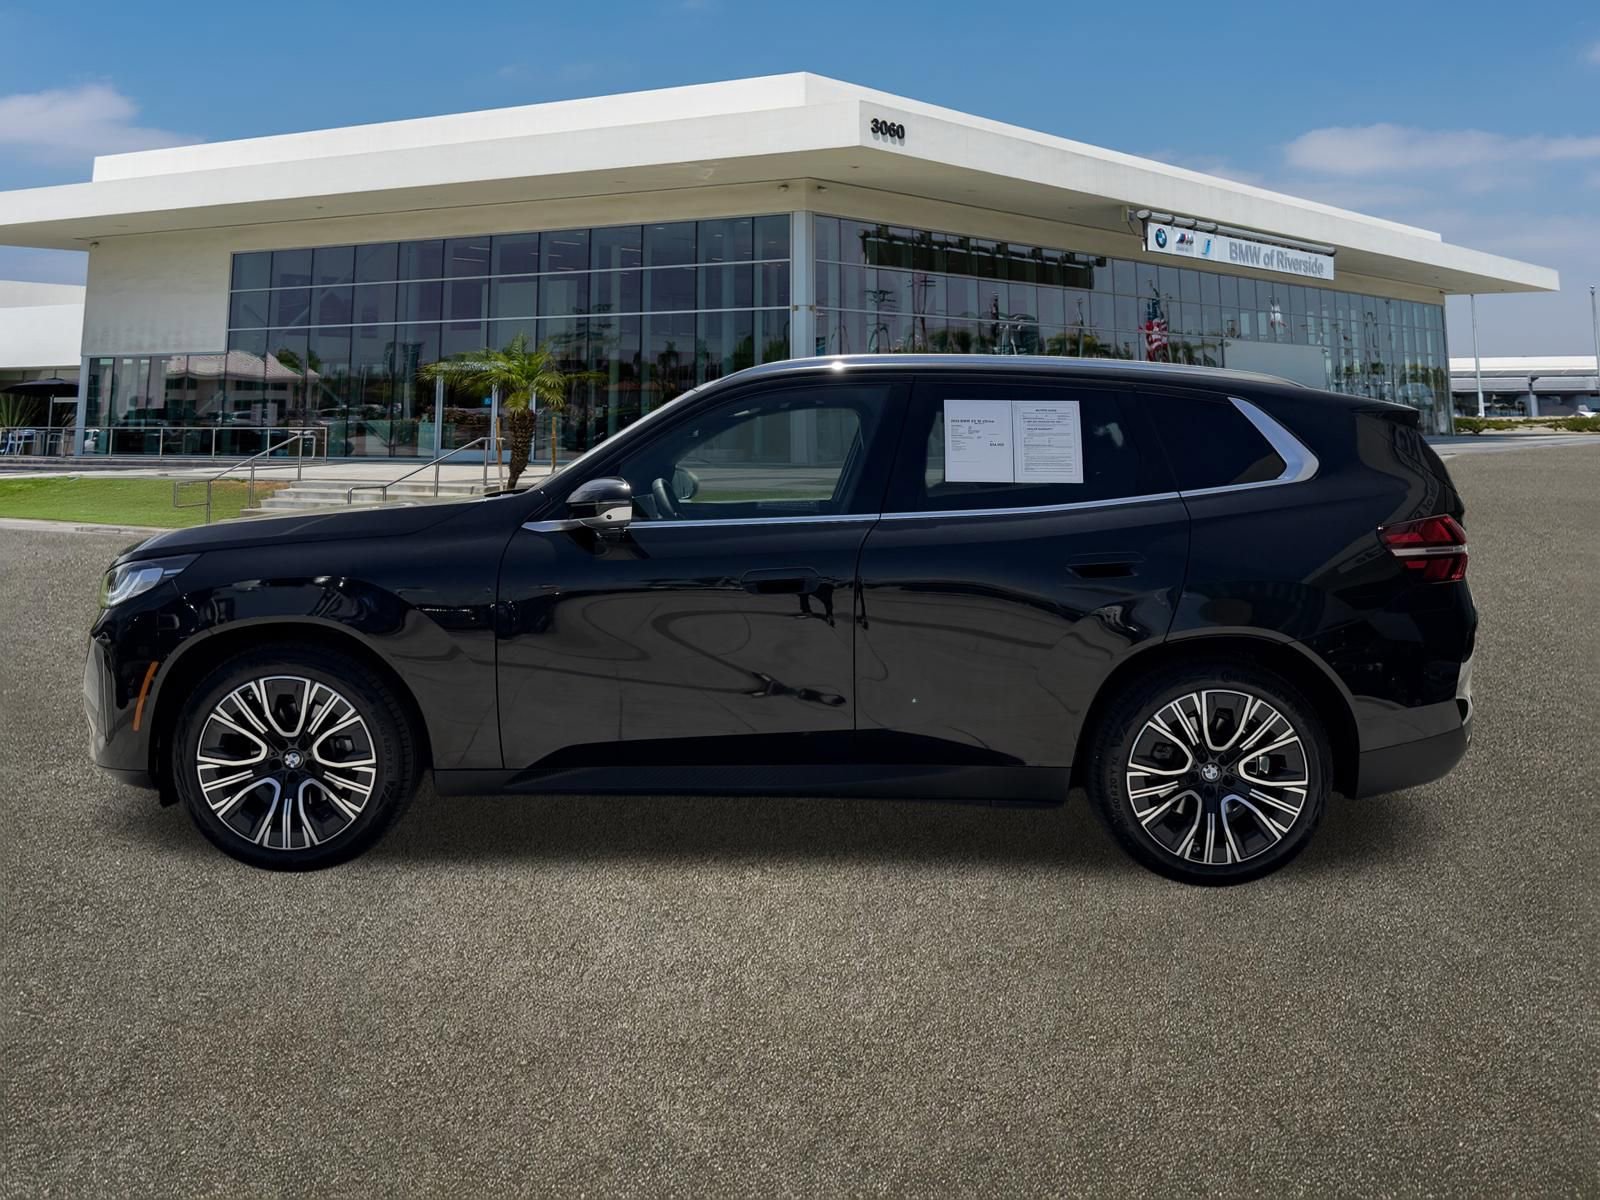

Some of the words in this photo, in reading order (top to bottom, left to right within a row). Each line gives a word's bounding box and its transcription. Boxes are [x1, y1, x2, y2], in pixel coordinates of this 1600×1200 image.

[871, 118, 905, 140] 3060
[1229, 242, 1261, 264] BMW
[1263, 249, 1275, 266] of
[1276, 252, 1324, 275] Riverside
